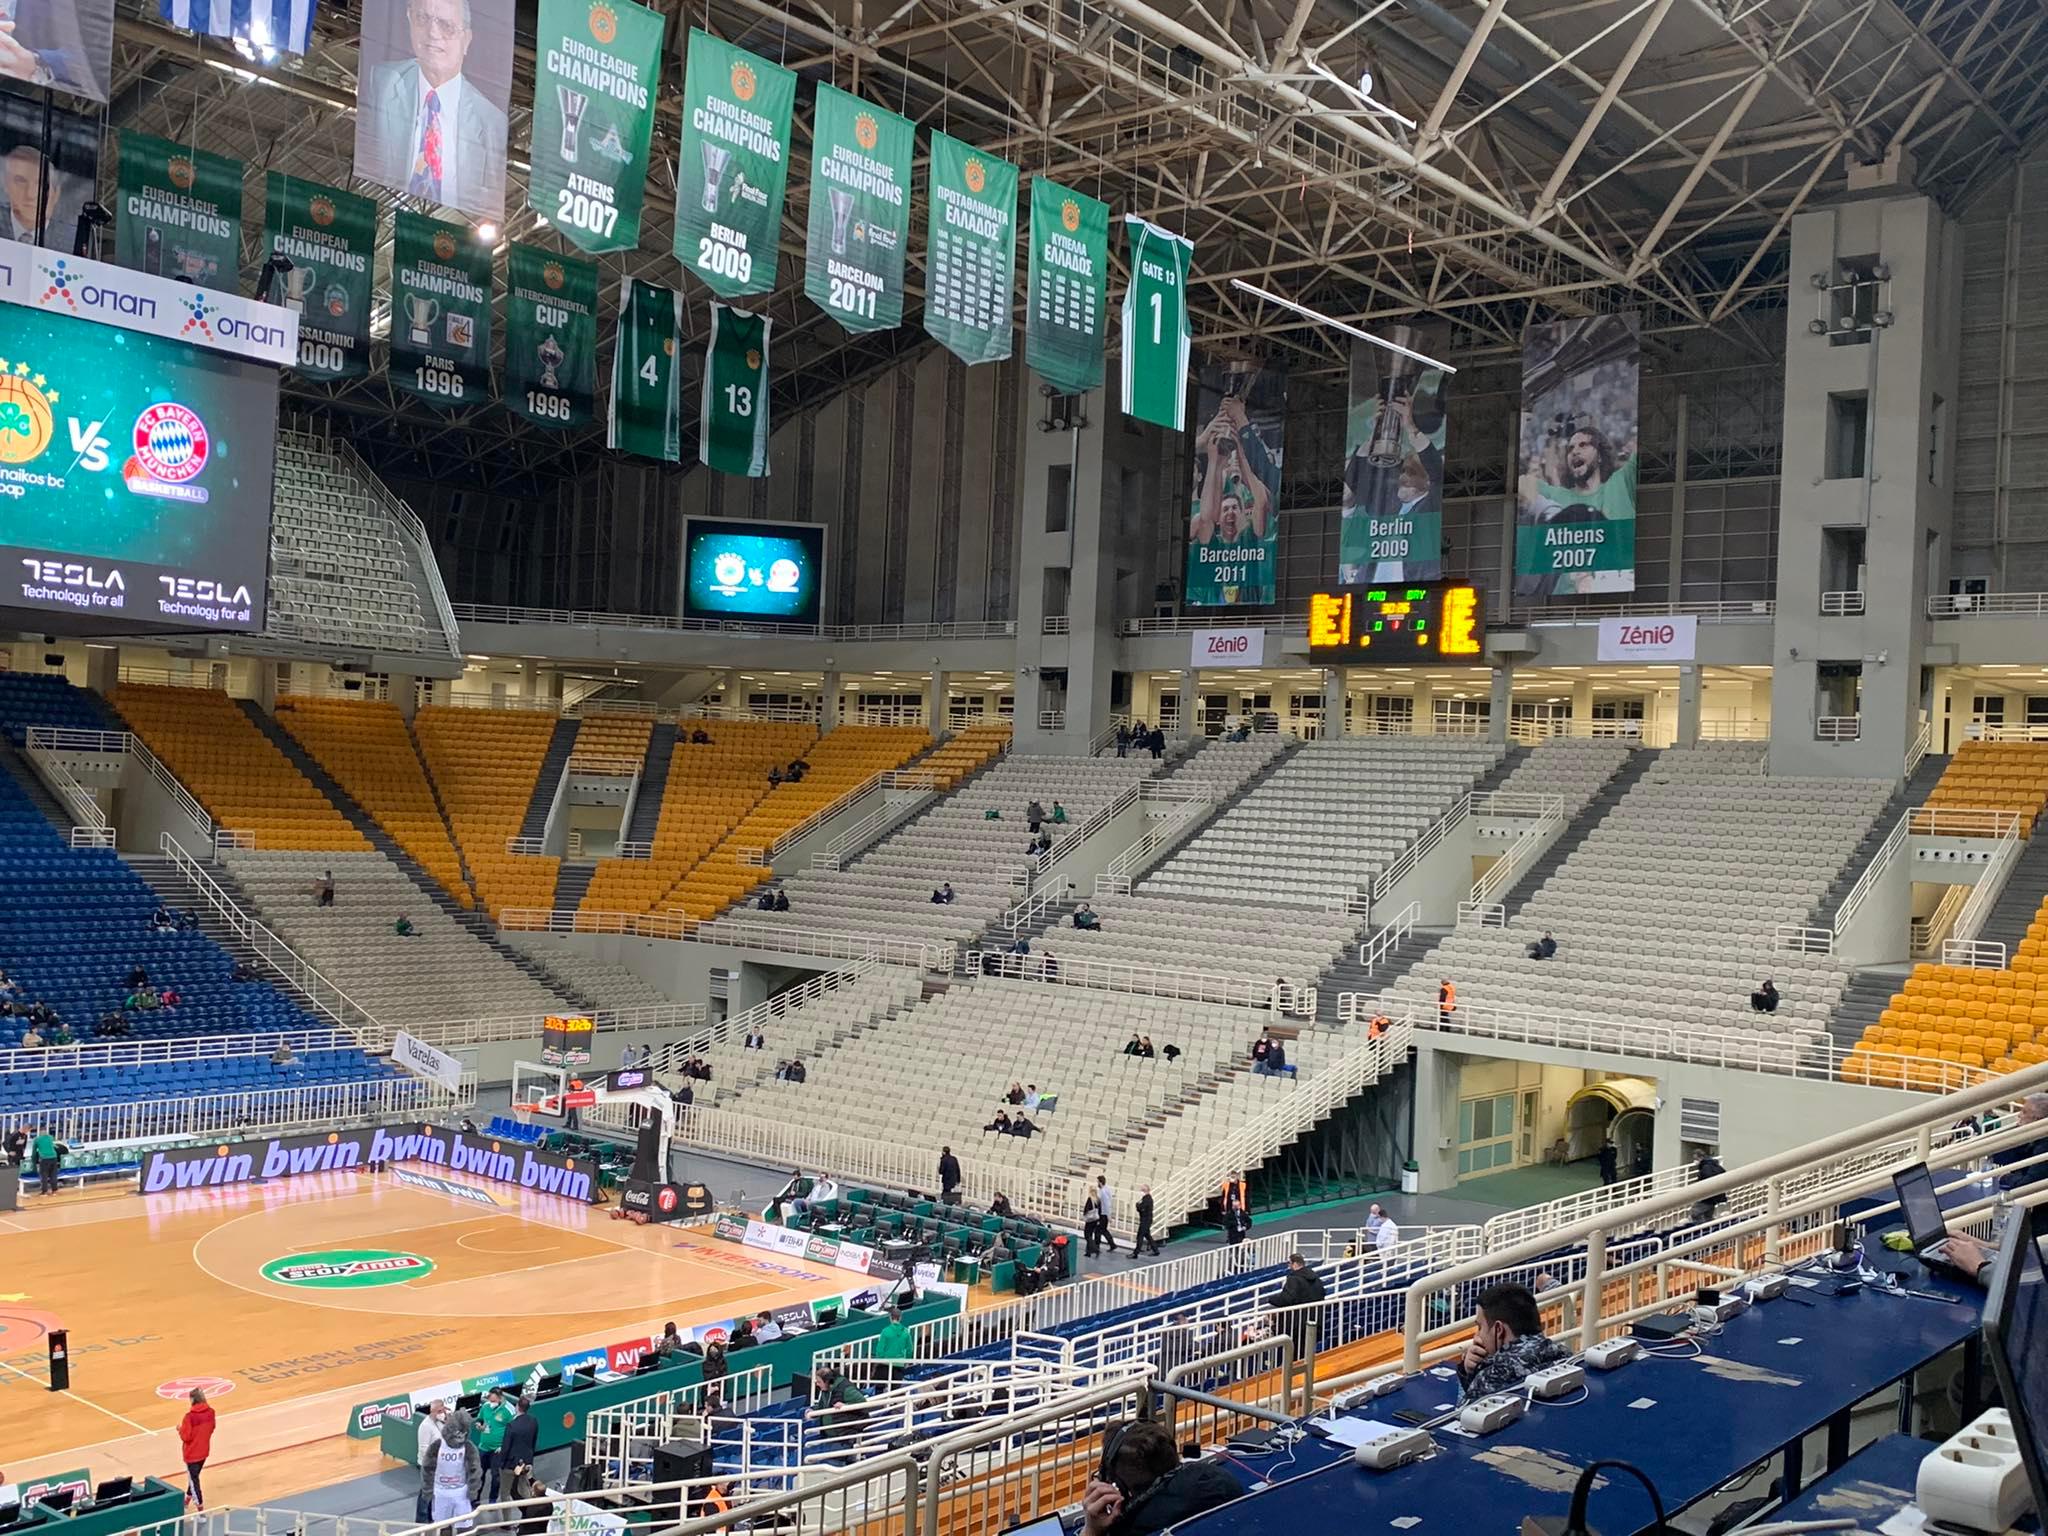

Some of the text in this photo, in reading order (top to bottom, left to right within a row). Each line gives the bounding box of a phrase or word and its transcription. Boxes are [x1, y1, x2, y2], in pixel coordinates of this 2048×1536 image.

[562, 36, 638, 82] EUROLEAGUE
[547, 50, 648, 110] CHAMPIONS
[706, 95, 773, 136] EUROLEAGUE
[693, 108, 781, 162] CHAMPIONS
[832, 144, 894, 182] EUROLEAGUE
[567, 173, 615, 203] ATHENS
[821, 156, 902, 206] CHAMPIONS
[142, 185, 218, 217] EUROLEAGUE
[557, 189, 618, 239] 2007
[937, 185, 1009, 226] ΠΡΩΤΑΘΛΗΜΑΤΑ
[128, 196, 230, 238] CHAMPIONS
[945, 203, 999, 242] ΕΛΛΑΔΟΣ
[292, 225, 348, 251] EUROPEAN
[710, 222, 747, 250] BERLIN
[1051, 232, 1087, 256] ΚΥΠΕΛΛΑ
[273, 235, 365, 273] CHAMPIONS
[698, 238, 752, 284] 2009
[1044, 245, 1093, 277] ΕΛΛΑΔΟΣ
[400, 269, 484, 304] CHAMPIONS
[417, 259, 468, 283] EUROPEAN
[827, 259, 884, 293] BARCELONA
[1141, 260, 1176, 286] GATE 13
[514, 286, 589, 316] INTERCONTINENTAL
[829, 278, 877, 319] 2011
[535, 304, 569, 329] CUP
[1149, 292, 1162, 344] 1
[297, 341, 344, 372] 000
[425, 354, 455, 371] PARIS
[640, 355, 659, 387] 4
[415, 367, 464, 398] 1996
[526, 391, 570, 420] 1996
[725, 383, 752, 417] 13
[140, 406, 204, 442] FC BAYERN
[67, 416, 111, 472] VS
[47, 472, 65, 488] bc
[132, 481, 205, 500] BASKETBALL
[1369, 518, 1414, 538] Berlin
[1544, 526, 1606, 548] Athens
[1199, 545, 1265, 566] Barcelona
[1370, 540, 1409, 559] 2009
[1551, 548, 1598, 569] 2007
[22, 558, 125, 590] TESLA
[158, 574, 251, 604] TESLA
[1213, 565, 1248, 584] 2011
[21, 583, 124, 608] Technology for all
[158, 599, 250, 622] Technology for all
[1374, 621, 1383, 631] 0
[1417, 620, 1425, 630] 0
[407, 1038, 441, 1071] Varelas
[871, 1258, 903, 1271] MATRIX
[778, 1310, 808, 1323] TESLA
[705, 1329, 727, 1343] NIKAS
[232, 1327, 458, 1377] TURKISH AIRLINES
